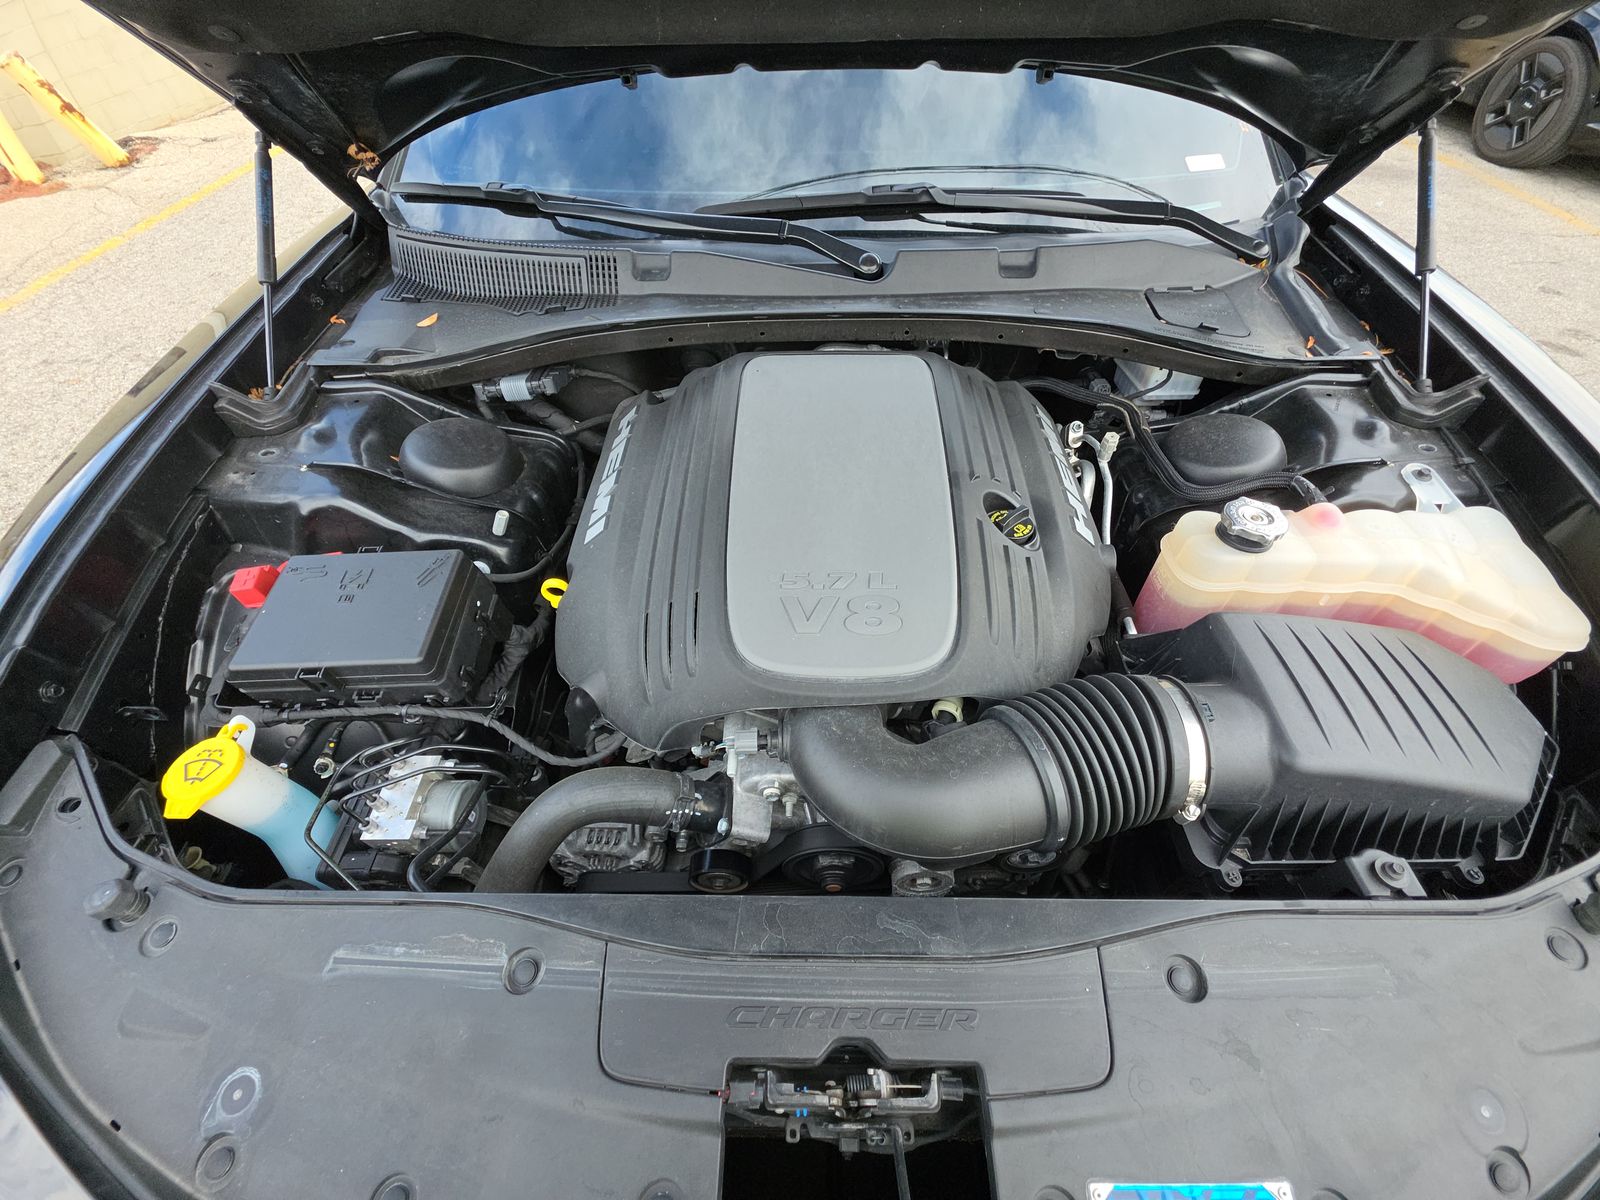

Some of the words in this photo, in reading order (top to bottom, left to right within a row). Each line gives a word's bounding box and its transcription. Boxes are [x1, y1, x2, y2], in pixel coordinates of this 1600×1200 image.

[583, 405, 638, 546] HEMI
[1035, 404, 1096, 547] HEMI
[778, 593, 904, 637] V8
[725, 1004, 980, 1032] CHARGER
